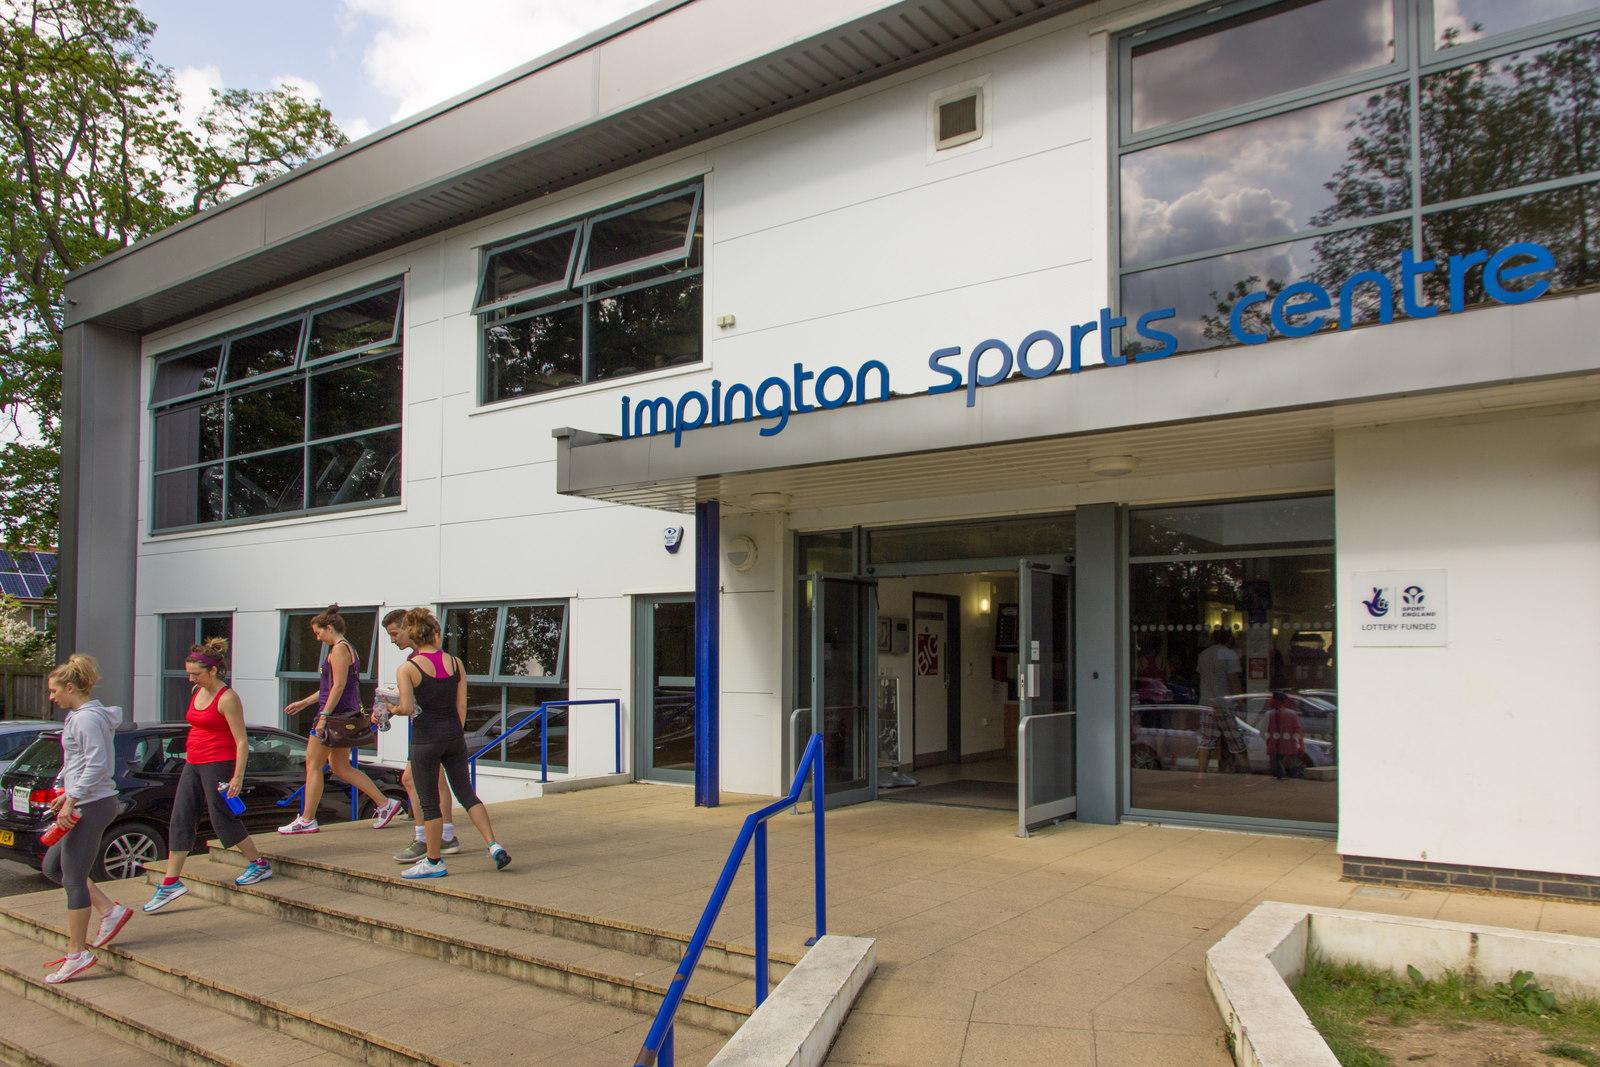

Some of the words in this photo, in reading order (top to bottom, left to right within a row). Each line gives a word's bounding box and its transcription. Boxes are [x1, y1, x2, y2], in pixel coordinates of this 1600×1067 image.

[621, 360, 890, 448] impington
[928, 307, 1178, 408] sports
[1230, 242, 1557, 346] centre
